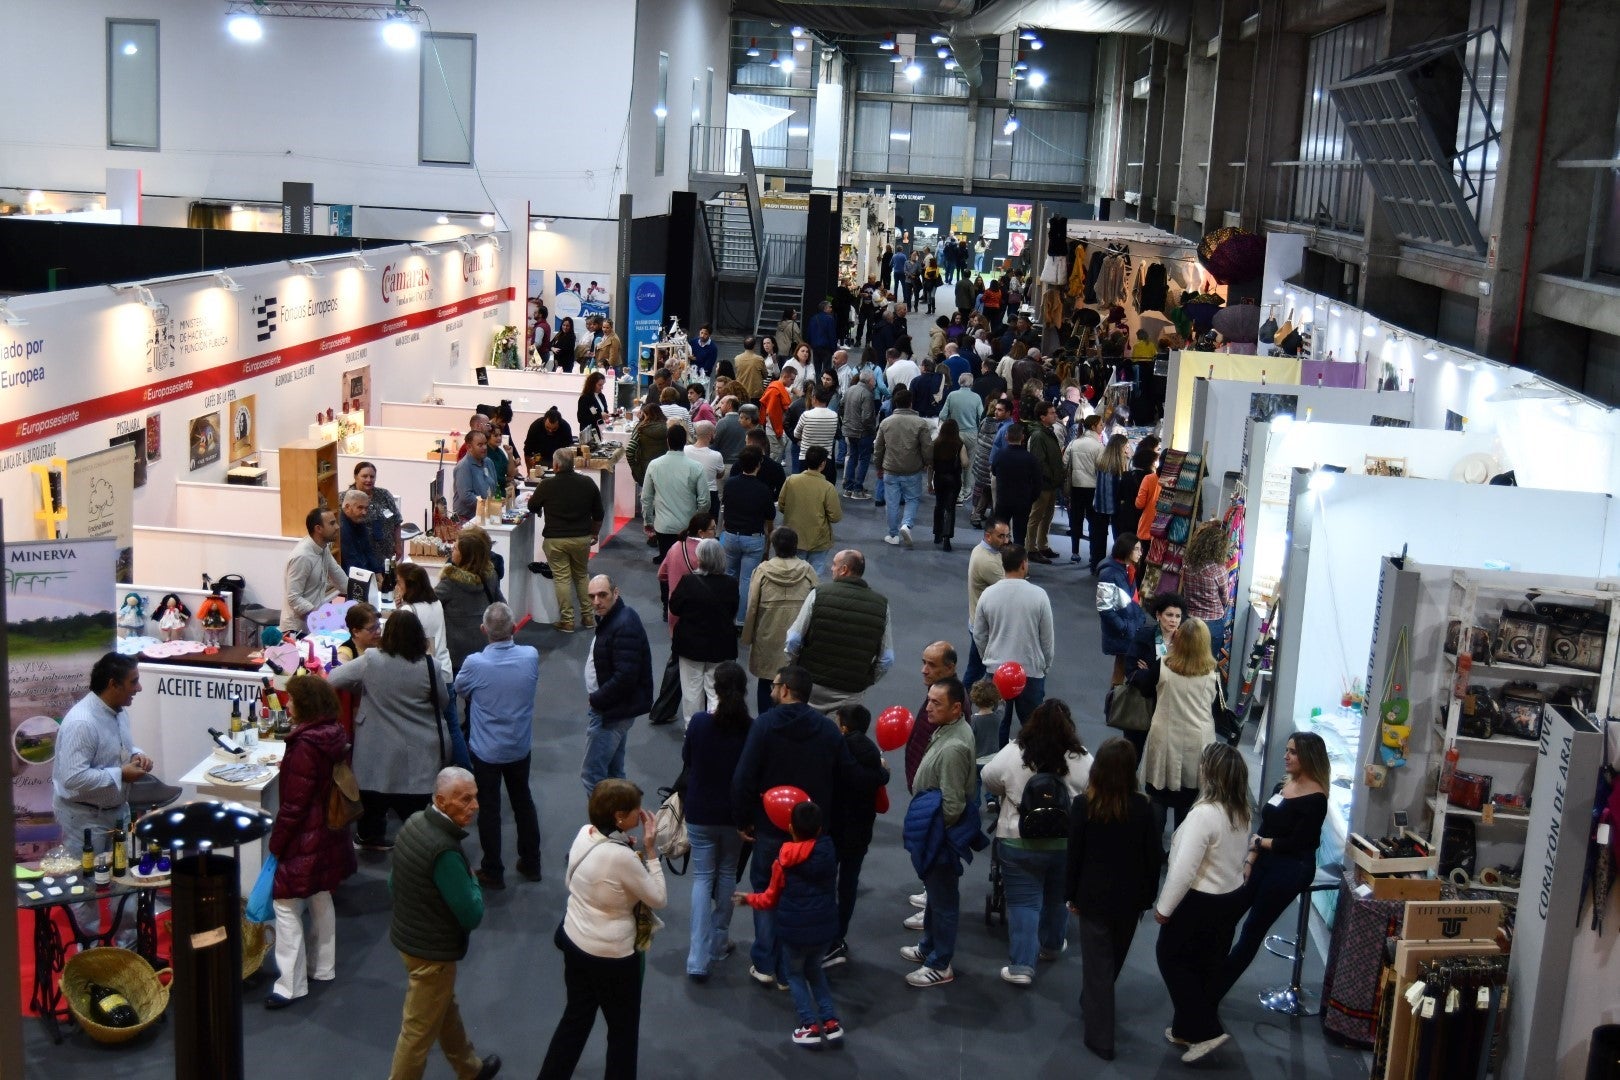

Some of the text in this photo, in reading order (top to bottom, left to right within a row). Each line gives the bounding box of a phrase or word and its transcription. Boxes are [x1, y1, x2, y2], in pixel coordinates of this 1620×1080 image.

[382, 261, 430, 303] Cámaras
[308, 298, 338, 318] Europeos
[26, 339, 44, 360] por
[1, 366, 45, 388] Europea
[143, 379, 194, 401] #Europasesiente
[16, 410, 80, 437] #Europasesiente
[22, 441, 57, 464] ALBURQUERQUE
[11, 549, 77, 562] MINERVA
[1363, 570, 1386, 716] ALMA DE CANARIAS
[158, 677, 264, 702] ACEITE EMÉRITA
[1540, 713, 1553, 757] VIVE
[1538, 736, 1573, 921] CORAZÓN DE ARA
[1418, 905, 1491, 915] TITTO BLUNI
